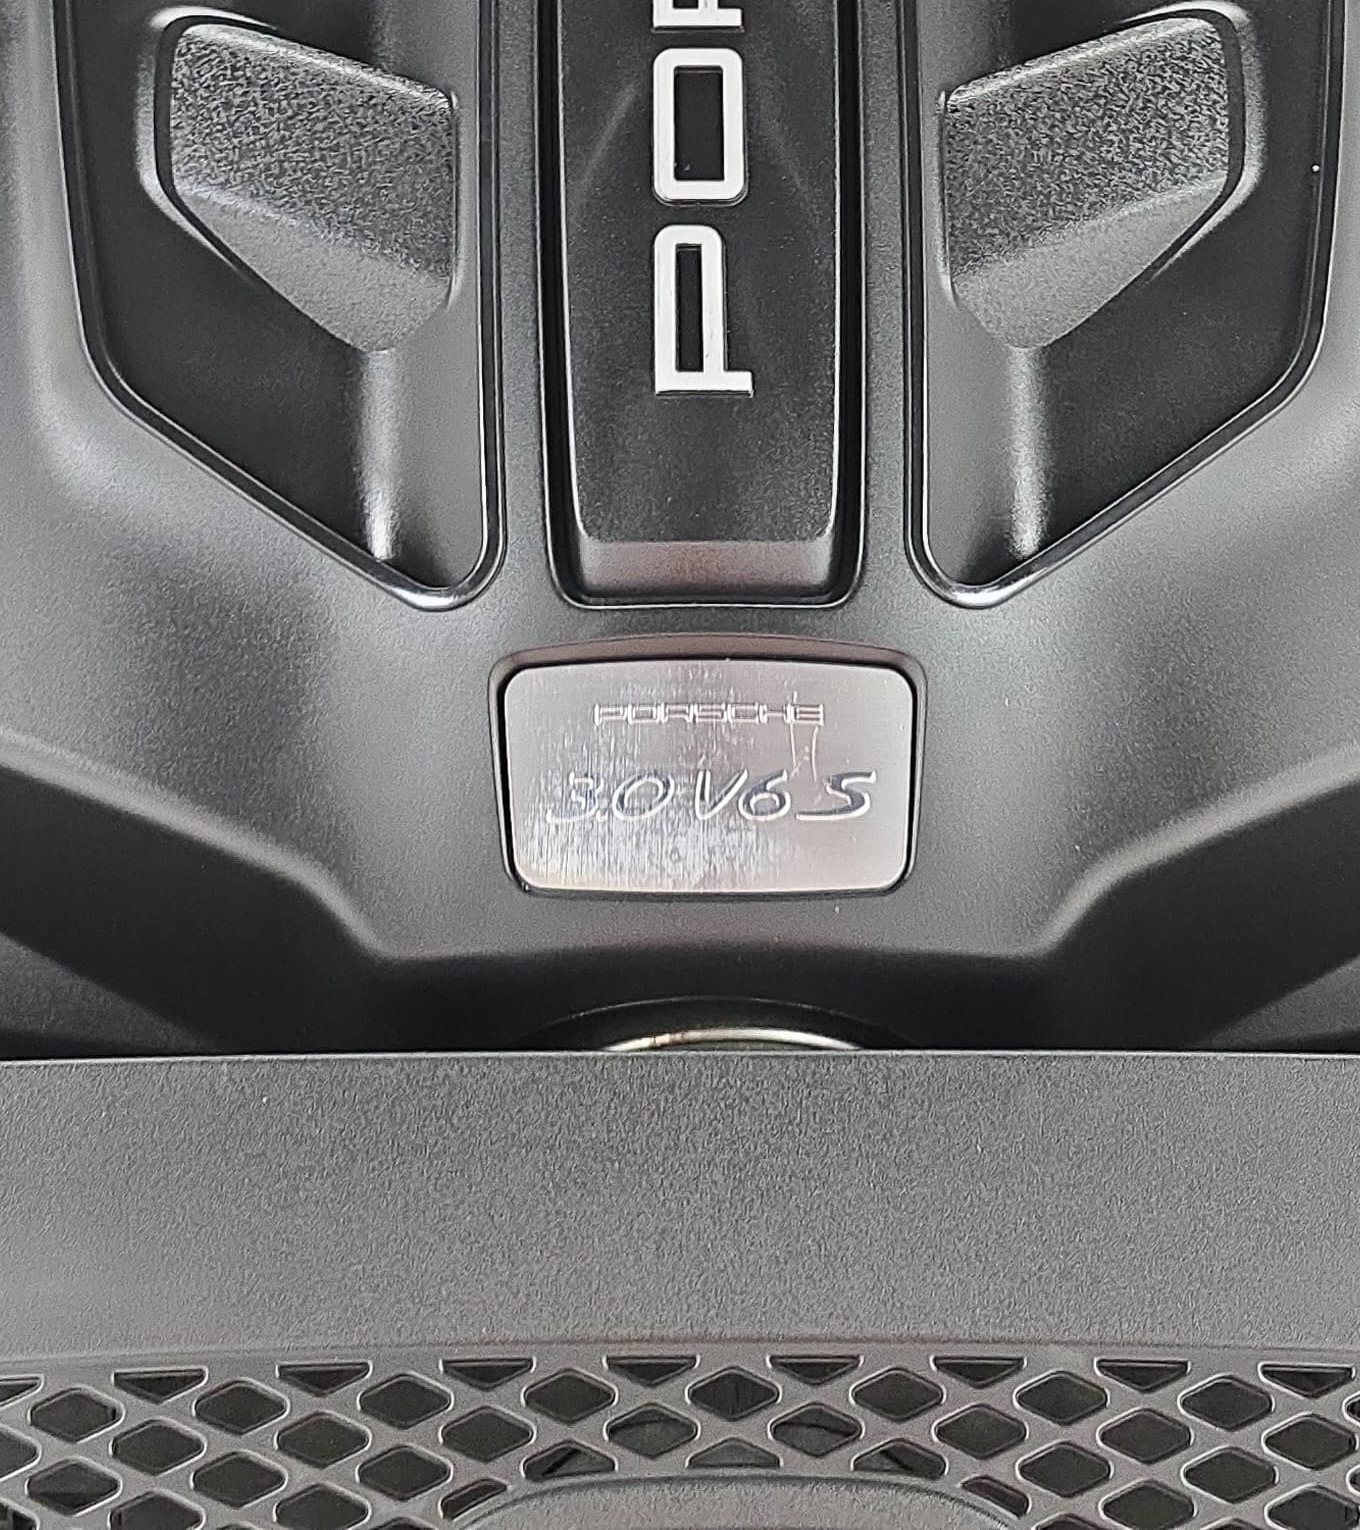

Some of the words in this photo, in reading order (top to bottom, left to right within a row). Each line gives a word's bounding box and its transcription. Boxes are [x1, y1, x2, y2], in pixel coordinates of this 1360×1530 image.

[593, 702, 824, 727] PORSCHE
[546, 770, 674, 823] 3.0
[693, 769, 793, 823] V6
[796, 771, 877, 822] S
